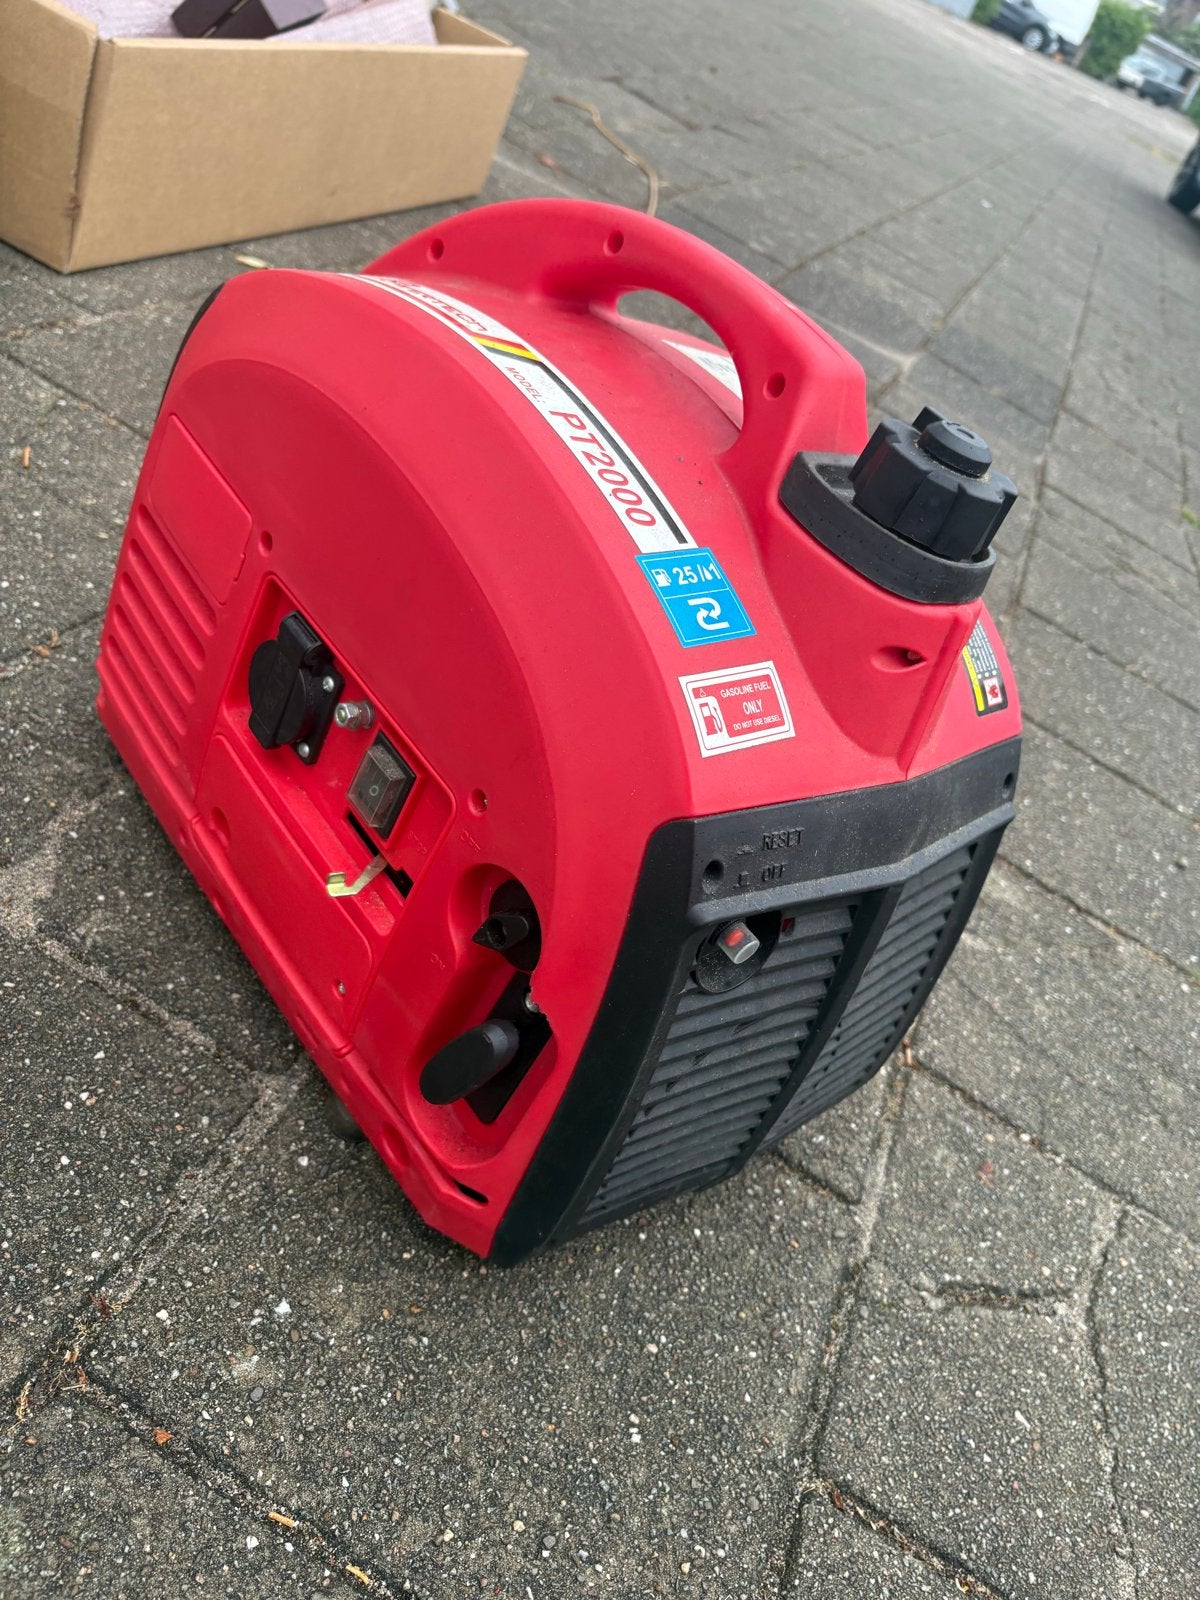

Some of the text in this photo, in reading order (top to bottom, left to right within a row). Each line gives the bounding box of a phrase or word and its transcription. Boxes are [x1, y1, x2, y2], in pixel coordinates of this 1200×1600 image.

[549, 410, 657, 528] PT2000
[720, 681, 771, 698] GASOLINE FUEL
[742, 699, 763, 715] ONLY
[733, 714, 781, 731] DO NOT USE DIESEL
[762, 827, 805, 851] RESET
[761, 863, 787, 882] OFF
